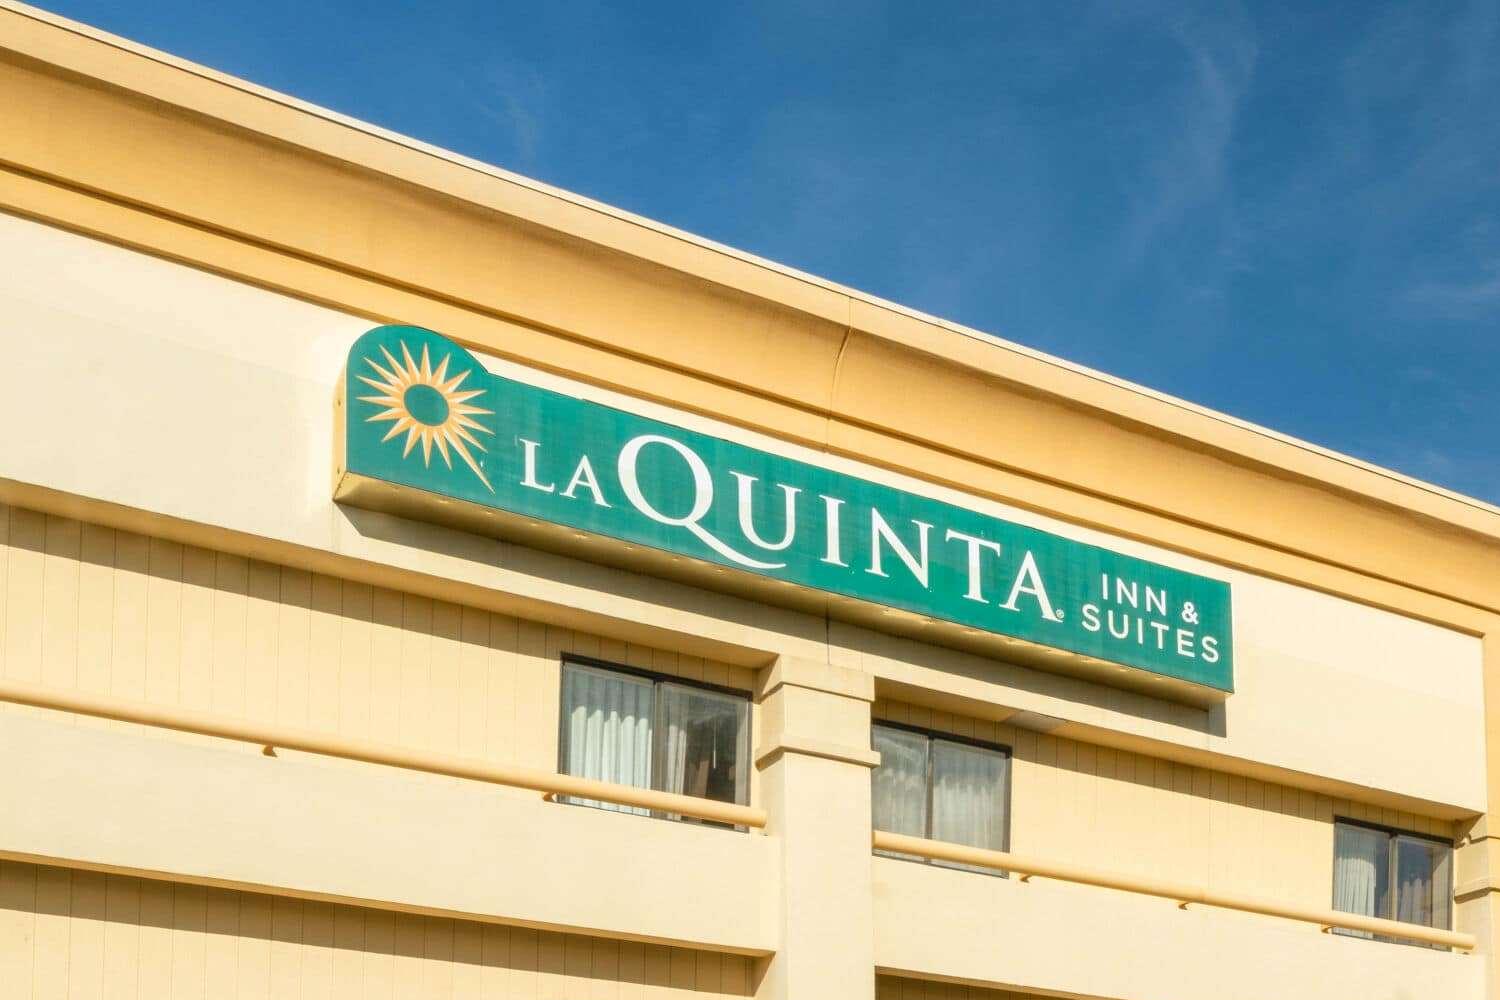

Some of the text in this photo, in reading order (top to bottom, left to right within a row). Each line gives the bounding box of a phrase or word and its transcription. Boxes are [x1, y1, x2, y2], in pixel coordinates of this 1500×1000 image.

[518, 434, 1064, 623] LA QUINTA
[1101, 572, 1200, 625] INN &
[1081, 603, 1220, 664] SUITES
